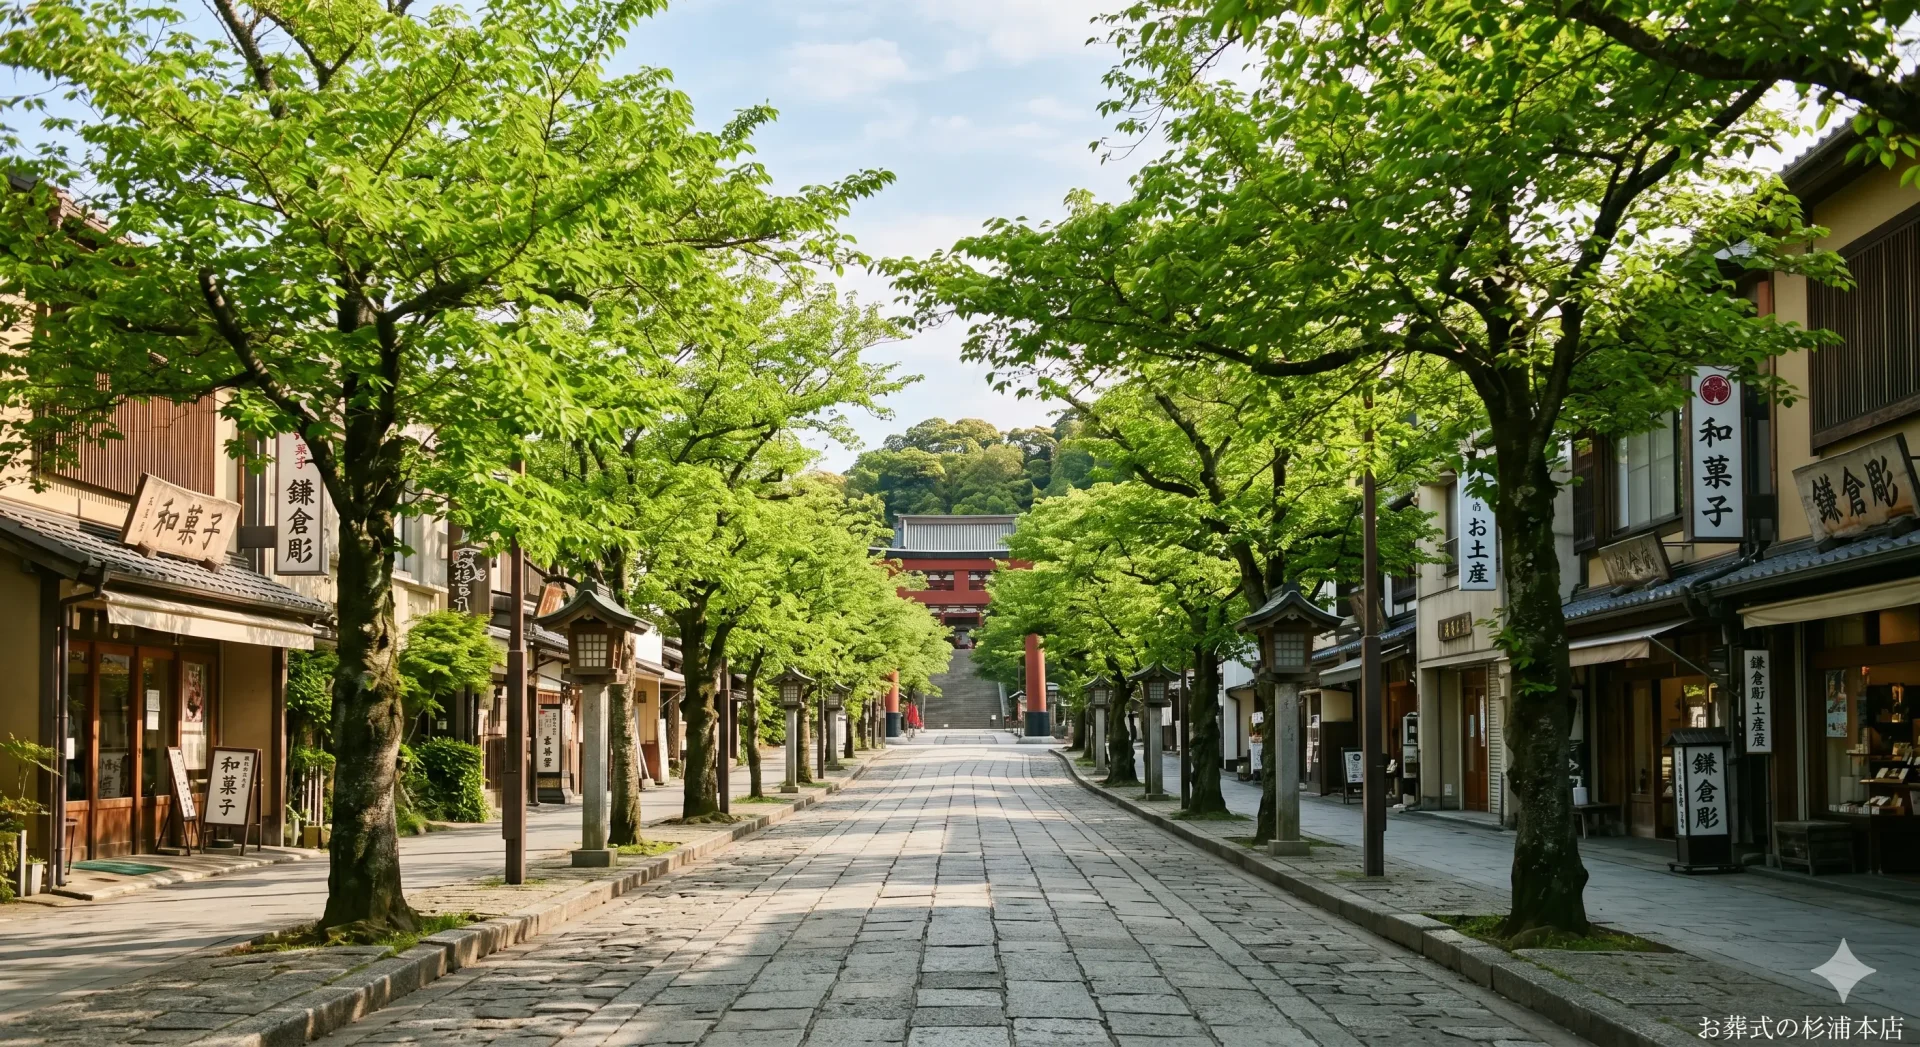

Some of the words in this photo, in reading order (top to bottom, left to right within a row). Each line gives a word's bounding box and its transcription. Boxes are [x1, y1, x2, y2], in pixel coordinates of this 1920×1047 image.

[1699, 416, 1734, 528] 和菓子
[1811, 455, 1899, 525] 鎌倉彫
[152, 497, 223, 551] 和菓子
[285, 478, 315, 564] 鎌倉彫
[1466, 517, 1489, 584] お土産
[218, 755, 241, 817] 和菓子
[1691, 751, 1720, 830] 鎌倉彫
